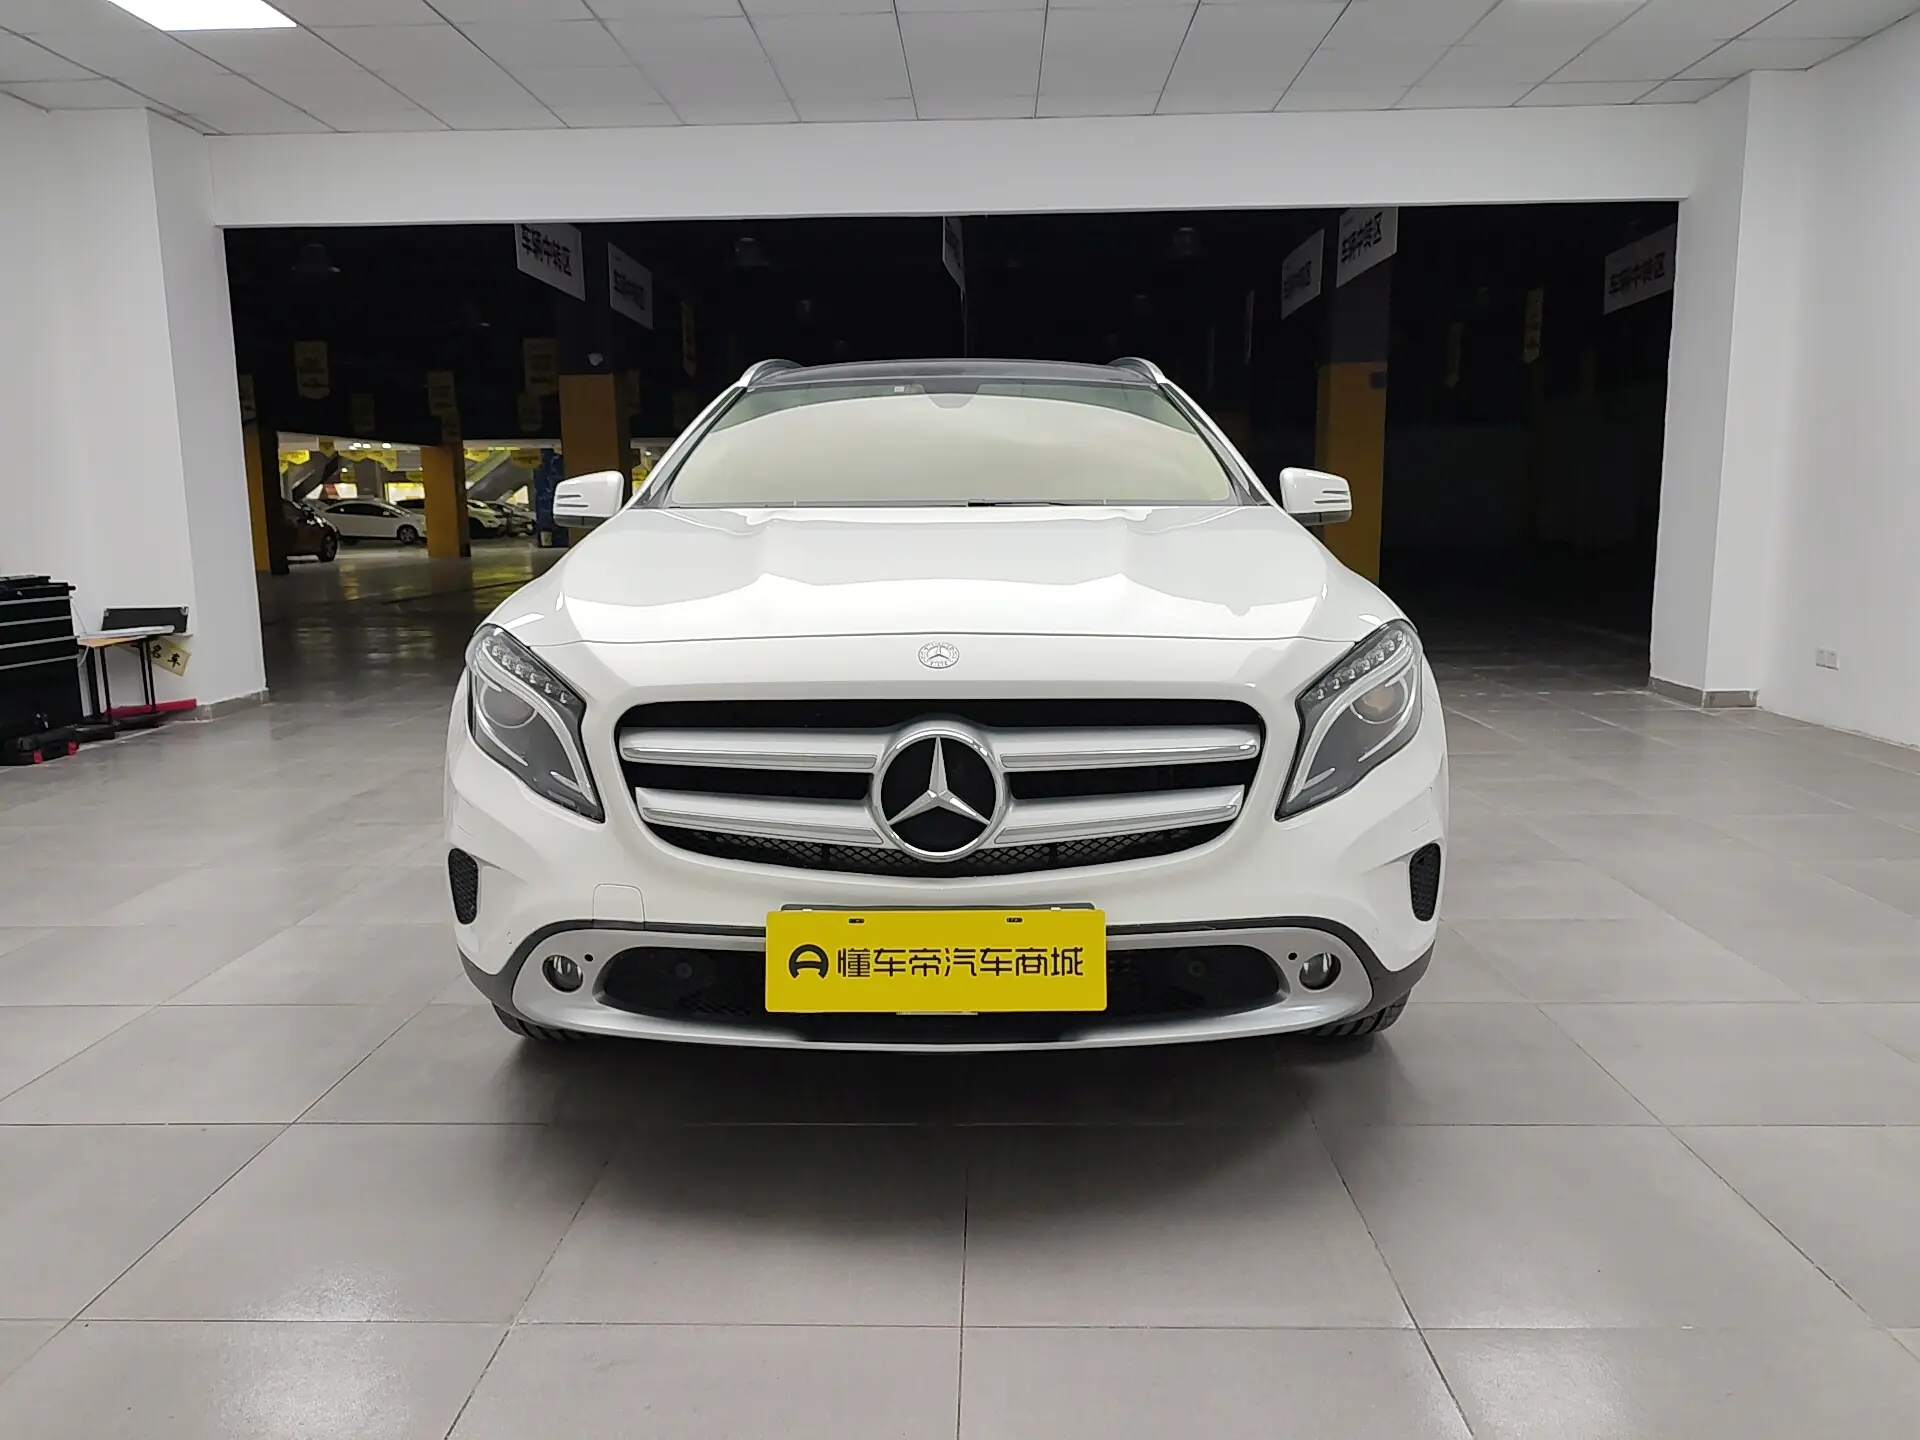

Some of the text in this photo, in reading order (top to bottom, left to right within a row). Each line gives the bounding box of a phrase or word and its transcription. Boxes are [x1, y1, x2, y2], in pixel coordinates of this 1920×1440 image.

[837, 946, 1084, 978] 懂车帝汽车商城
